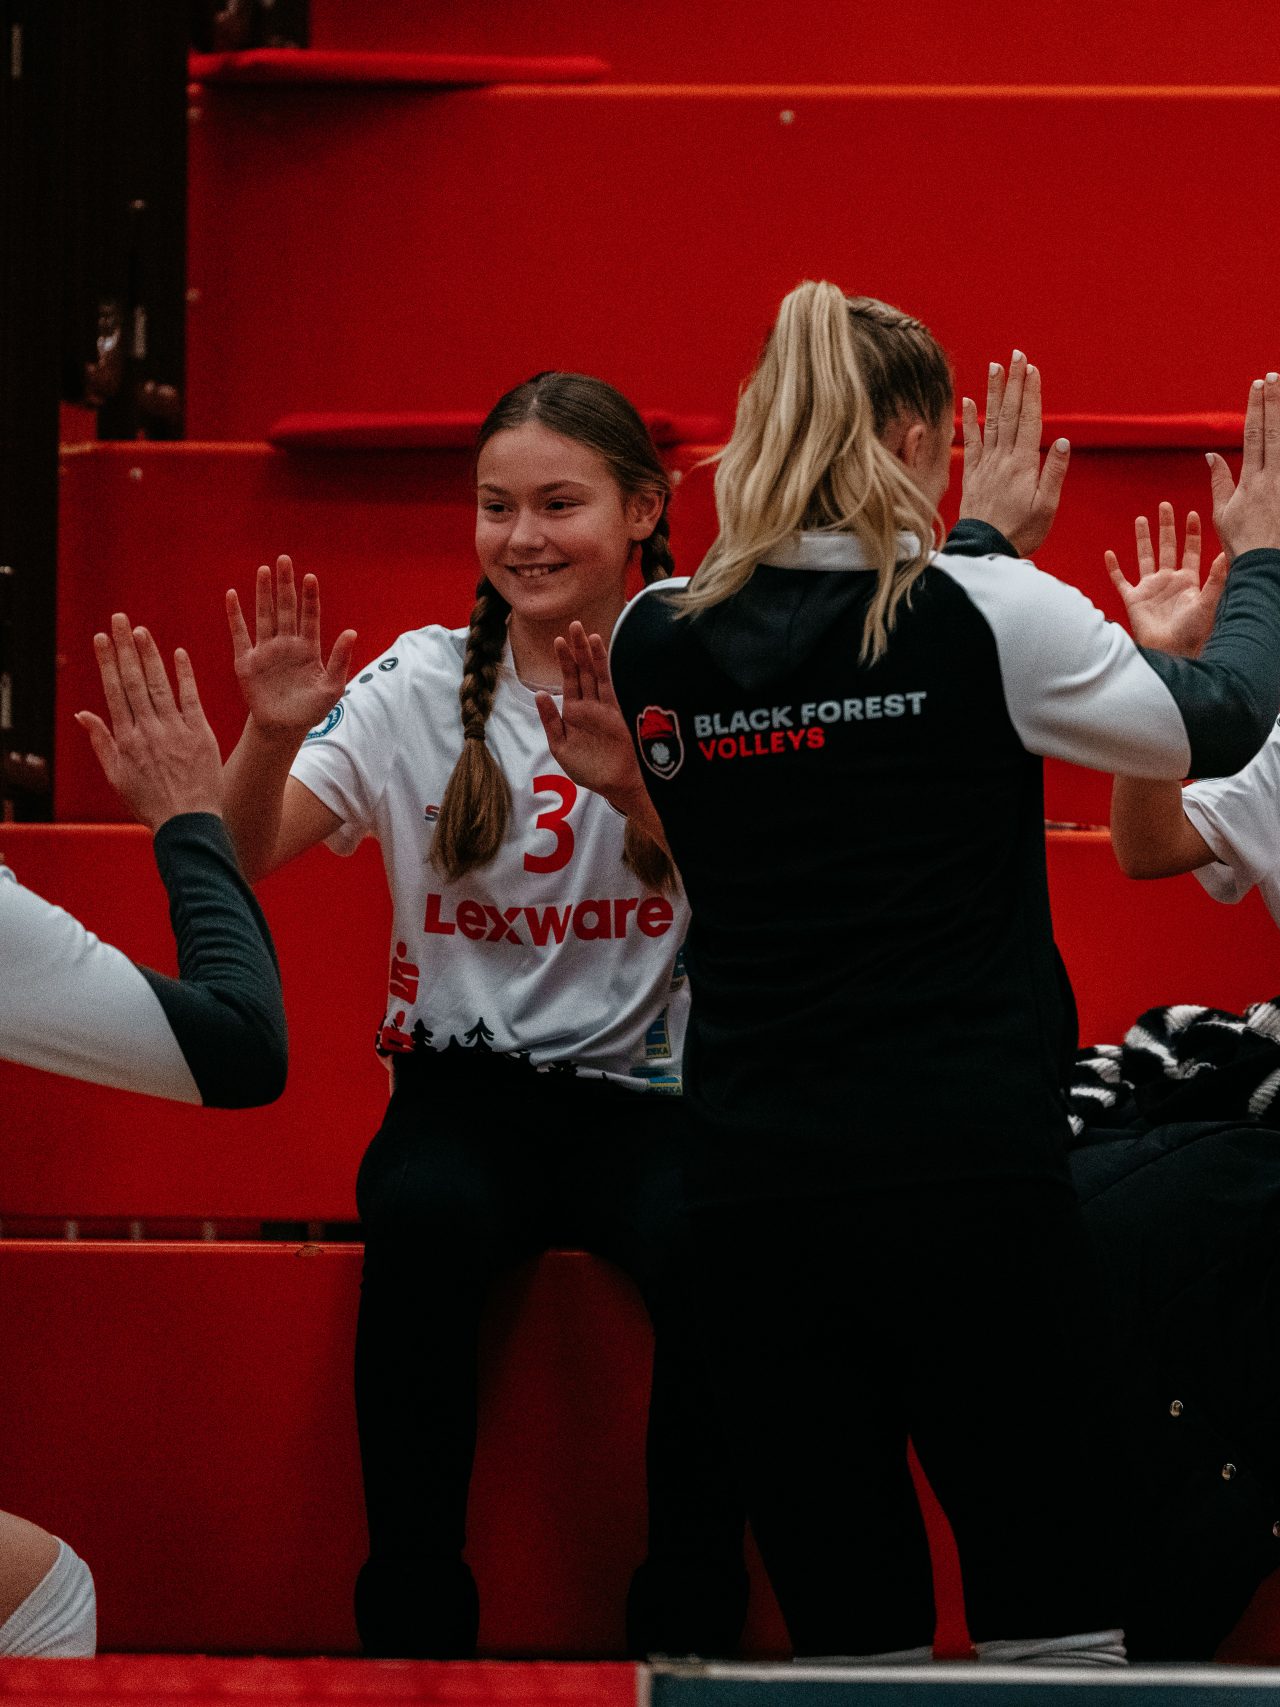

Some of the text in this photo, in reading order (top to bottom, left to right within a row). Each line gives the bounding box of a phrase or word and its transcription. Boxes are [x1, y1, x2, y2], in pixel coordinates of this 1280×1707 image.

[694, 691, 927, 738] BLACK FOREST
[698, 726, 826, 761] VOLLEYS
[523, 774, 577, 874] 3
[423, 893, 674, 946] Lexware
